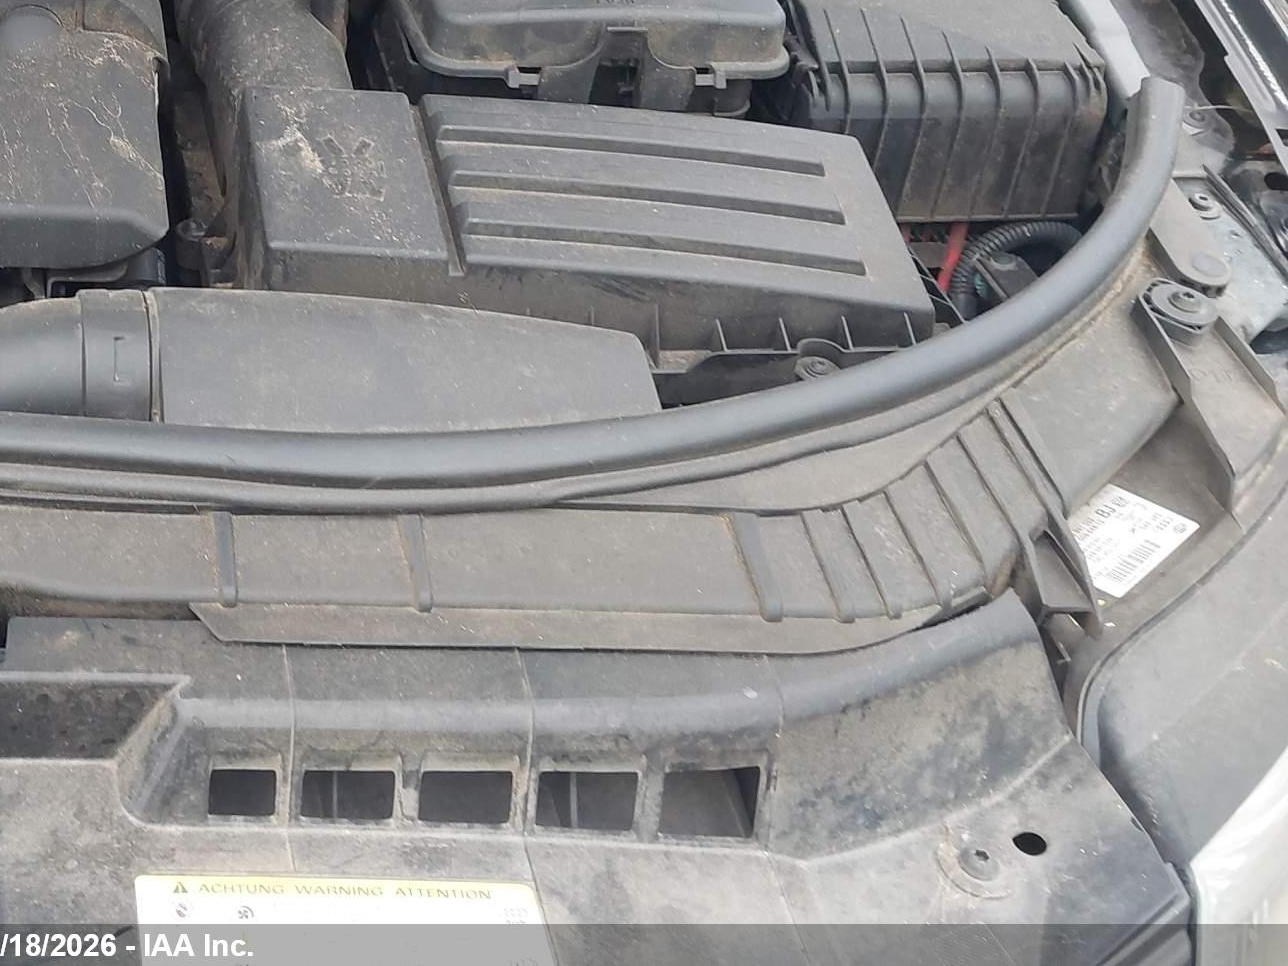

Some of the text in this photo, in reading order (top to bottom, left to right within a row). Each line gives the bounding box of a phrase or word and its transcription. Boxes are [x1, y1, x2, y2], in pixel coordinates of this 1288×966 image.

[199, 883, 492, 900] ACHTUNG WARNING ATTENTION
